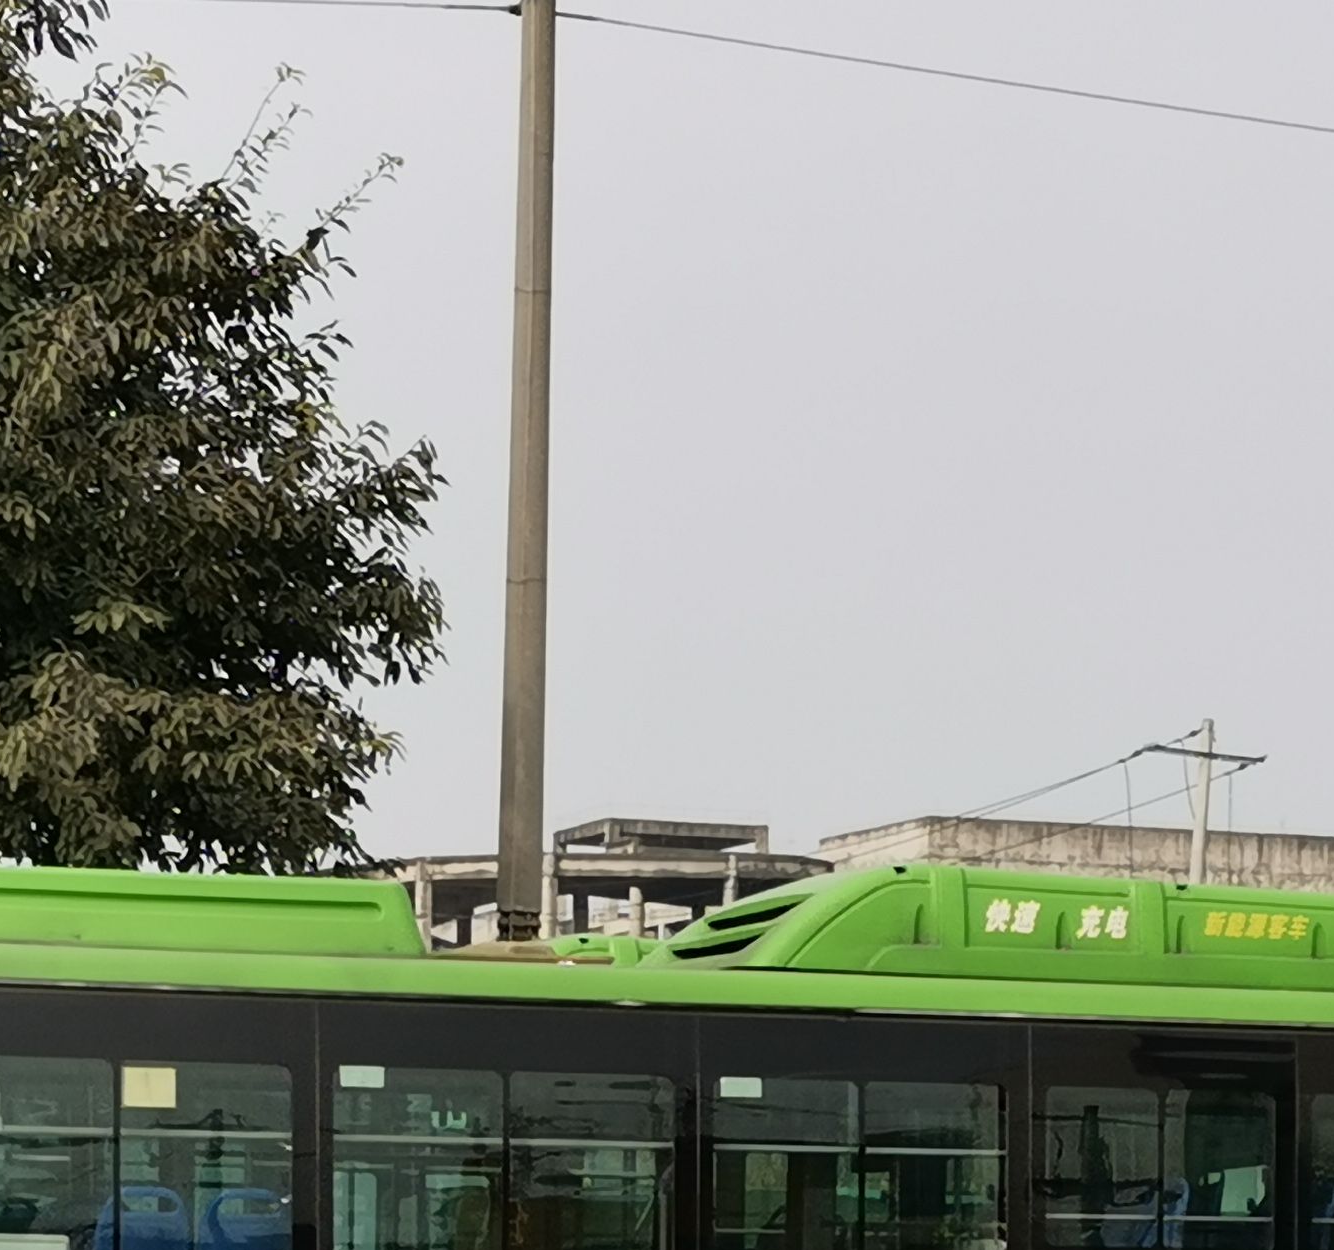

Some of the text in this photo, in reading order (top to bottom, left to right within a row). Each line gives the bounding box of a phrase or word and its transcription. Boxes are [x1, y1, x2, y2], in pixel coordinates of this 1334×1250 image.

[985, 899, 1129, 939] 快速 充电
[1204, 911, 1310, 940] 新能源客车
